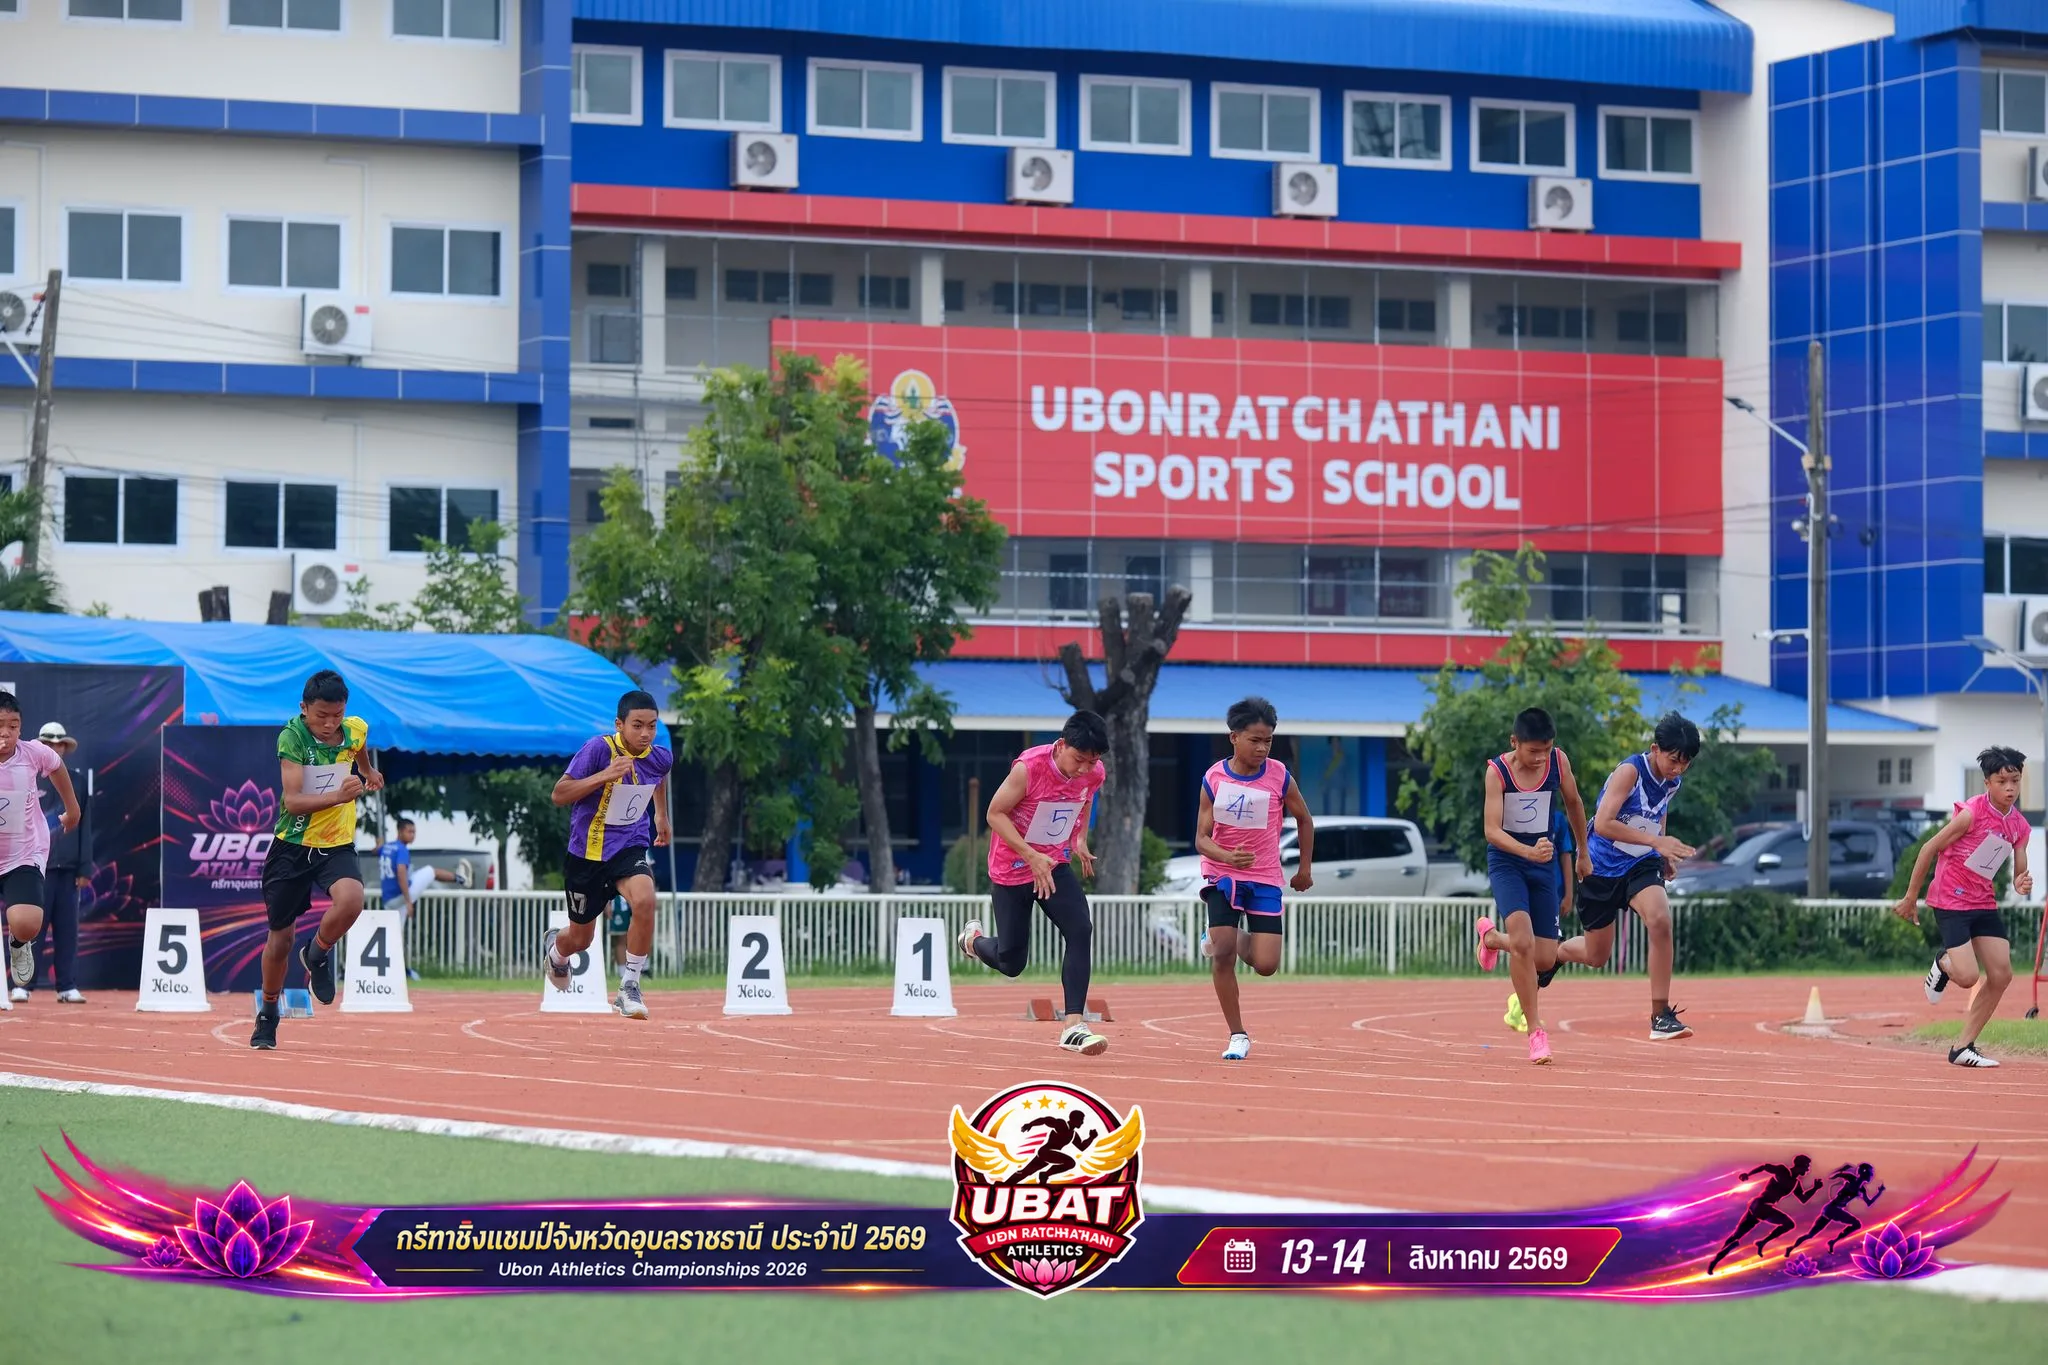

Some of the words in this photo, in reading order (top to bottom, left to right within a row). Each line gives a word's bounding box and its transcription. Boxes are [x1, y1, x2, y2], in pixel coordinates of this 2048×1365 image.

[1031, 385, 1560, 450] UBONRATCHATHANI
[1093, 452, 1294, 503] SPORTS
[1322, 460, 1520, 511] SCHOOL
[315, 772, 335, 795] 7
[624, 793, 642, 820] 6
[1226, 794, 1254, 820] 4
[1515, 798, 1538, 824] 3
[1046, 809, 1073, 837] 5
[190, 862, 264, 877] ATHLE
[1980, 845, 2003, 870] 1
[568, 890, 587, 915] 17
[157, 925, 188, 975] 5
[360, 927, 391, 977] 4
[741, 932, 770, 980] 2
[913, 932, 932, 981] 1
[152, 978, 189, 994] Nelco
[356, 979, 391, 995] Nelco
[737, 984, 772, 998] Nelco
[904, 983, 937, 998] Nelco
